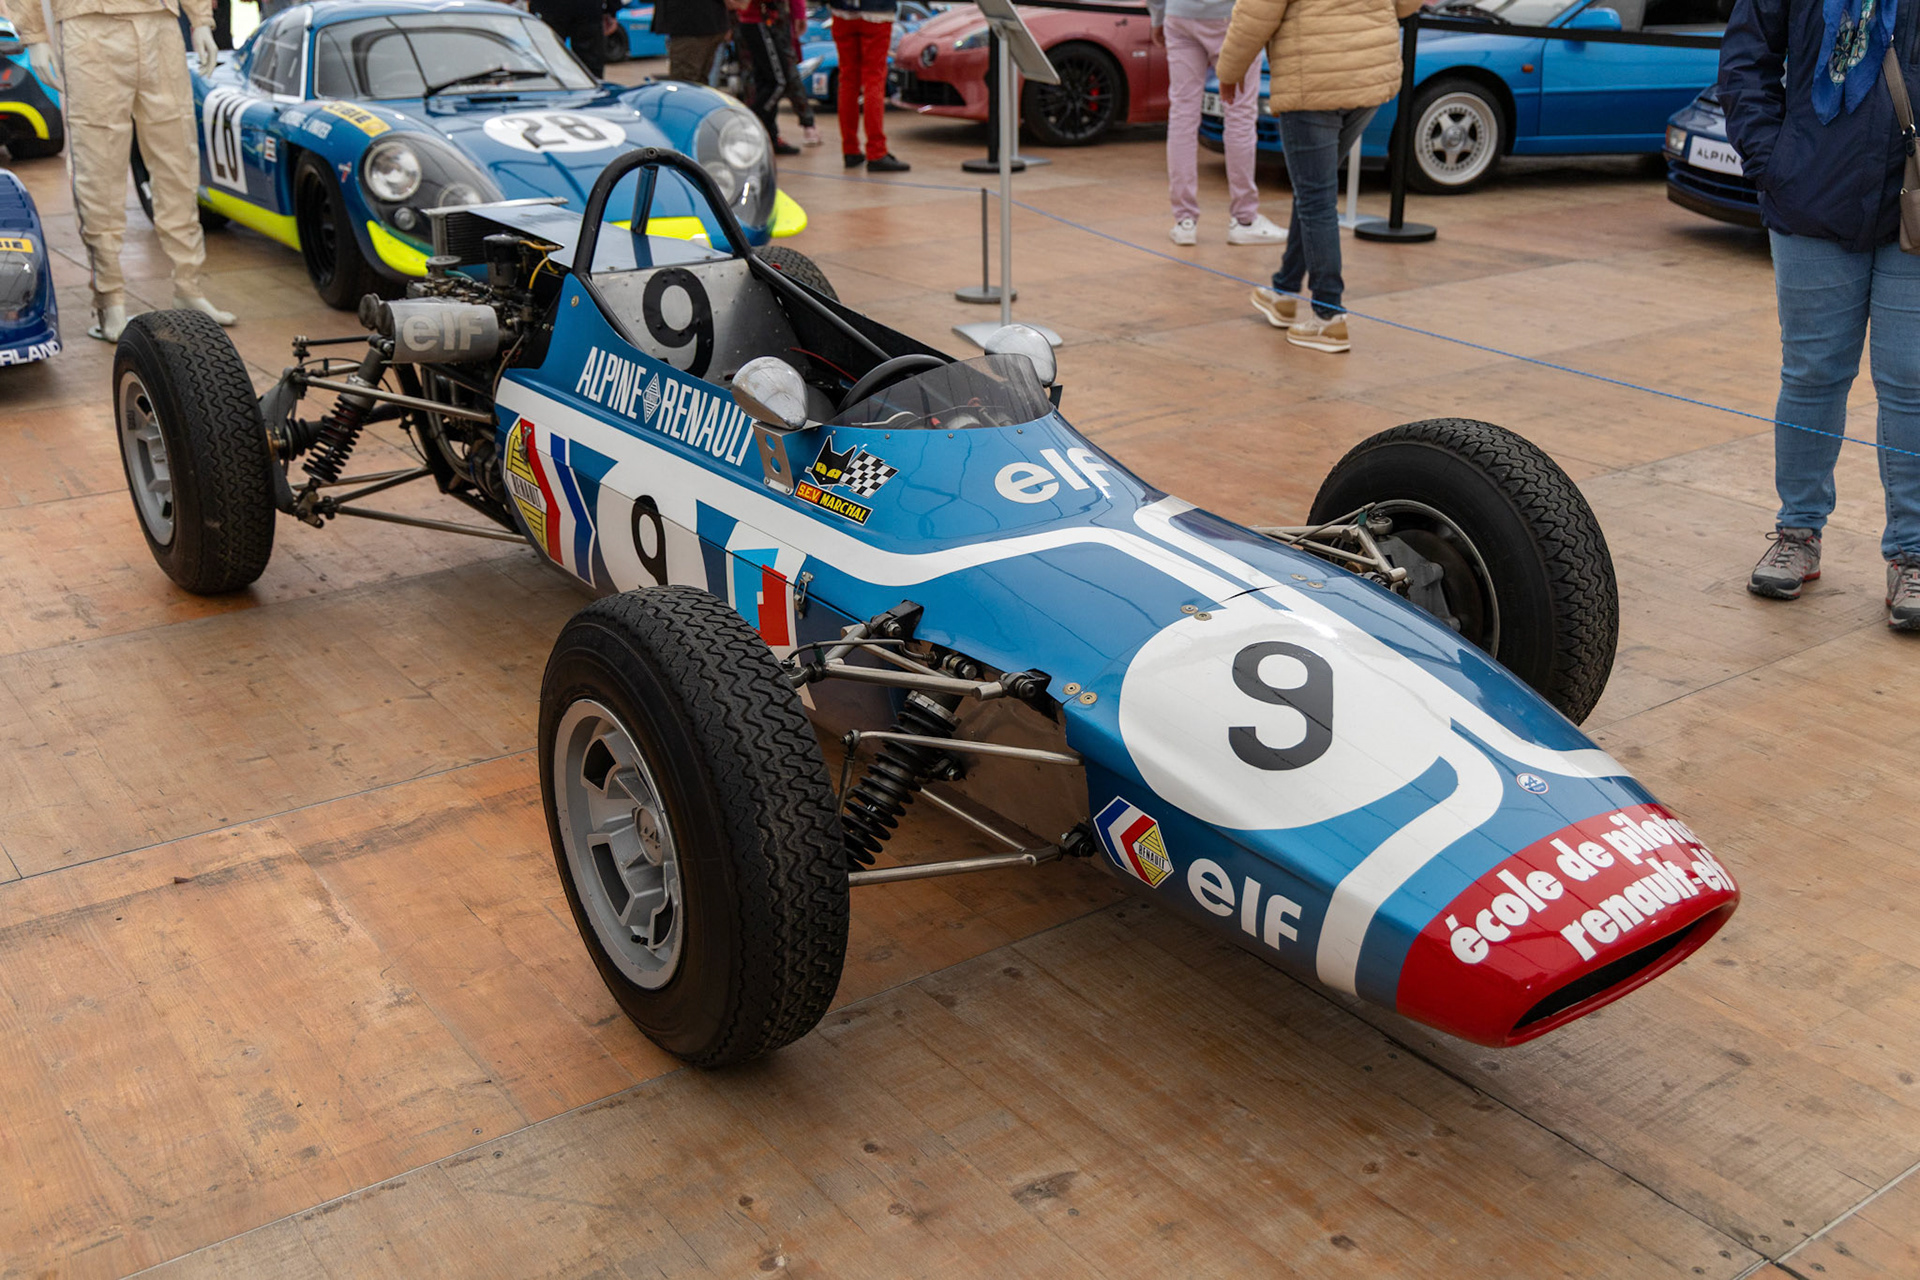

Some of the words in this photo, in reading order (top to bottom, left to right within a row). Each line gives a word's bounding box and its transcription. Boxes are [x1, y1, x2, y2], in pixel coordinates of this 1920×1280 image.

[501, 116, 607, 149] 28
[1697, 147, 1737, 165] ALPIN
[403, 310, 483, 352] elf
[643, 267, 714, 380] 9
[575, 346, 647, 420] ALPINE
[655, 378, 756, 467] RENAULT
[510, 473, 542, 509] RENAULT
[797, 484, 821, 503] S.E.V.
[819, 494, 867, 522] MARCHAL
[994, 447, 1111, 504] elf
[631, 494, 669, 588] 9
[1228, 640, 1334, 771] 9
[1137, 843, 1166, 870] RENAULT
[1445, 868, 1565, 965] école
[1550, 838, 1615, 882] de
[1600, 812, 1706, 866] pilota
[1187, 858, 1303, 951] elf
[1560, 848, 1736, 962] renault-elf
